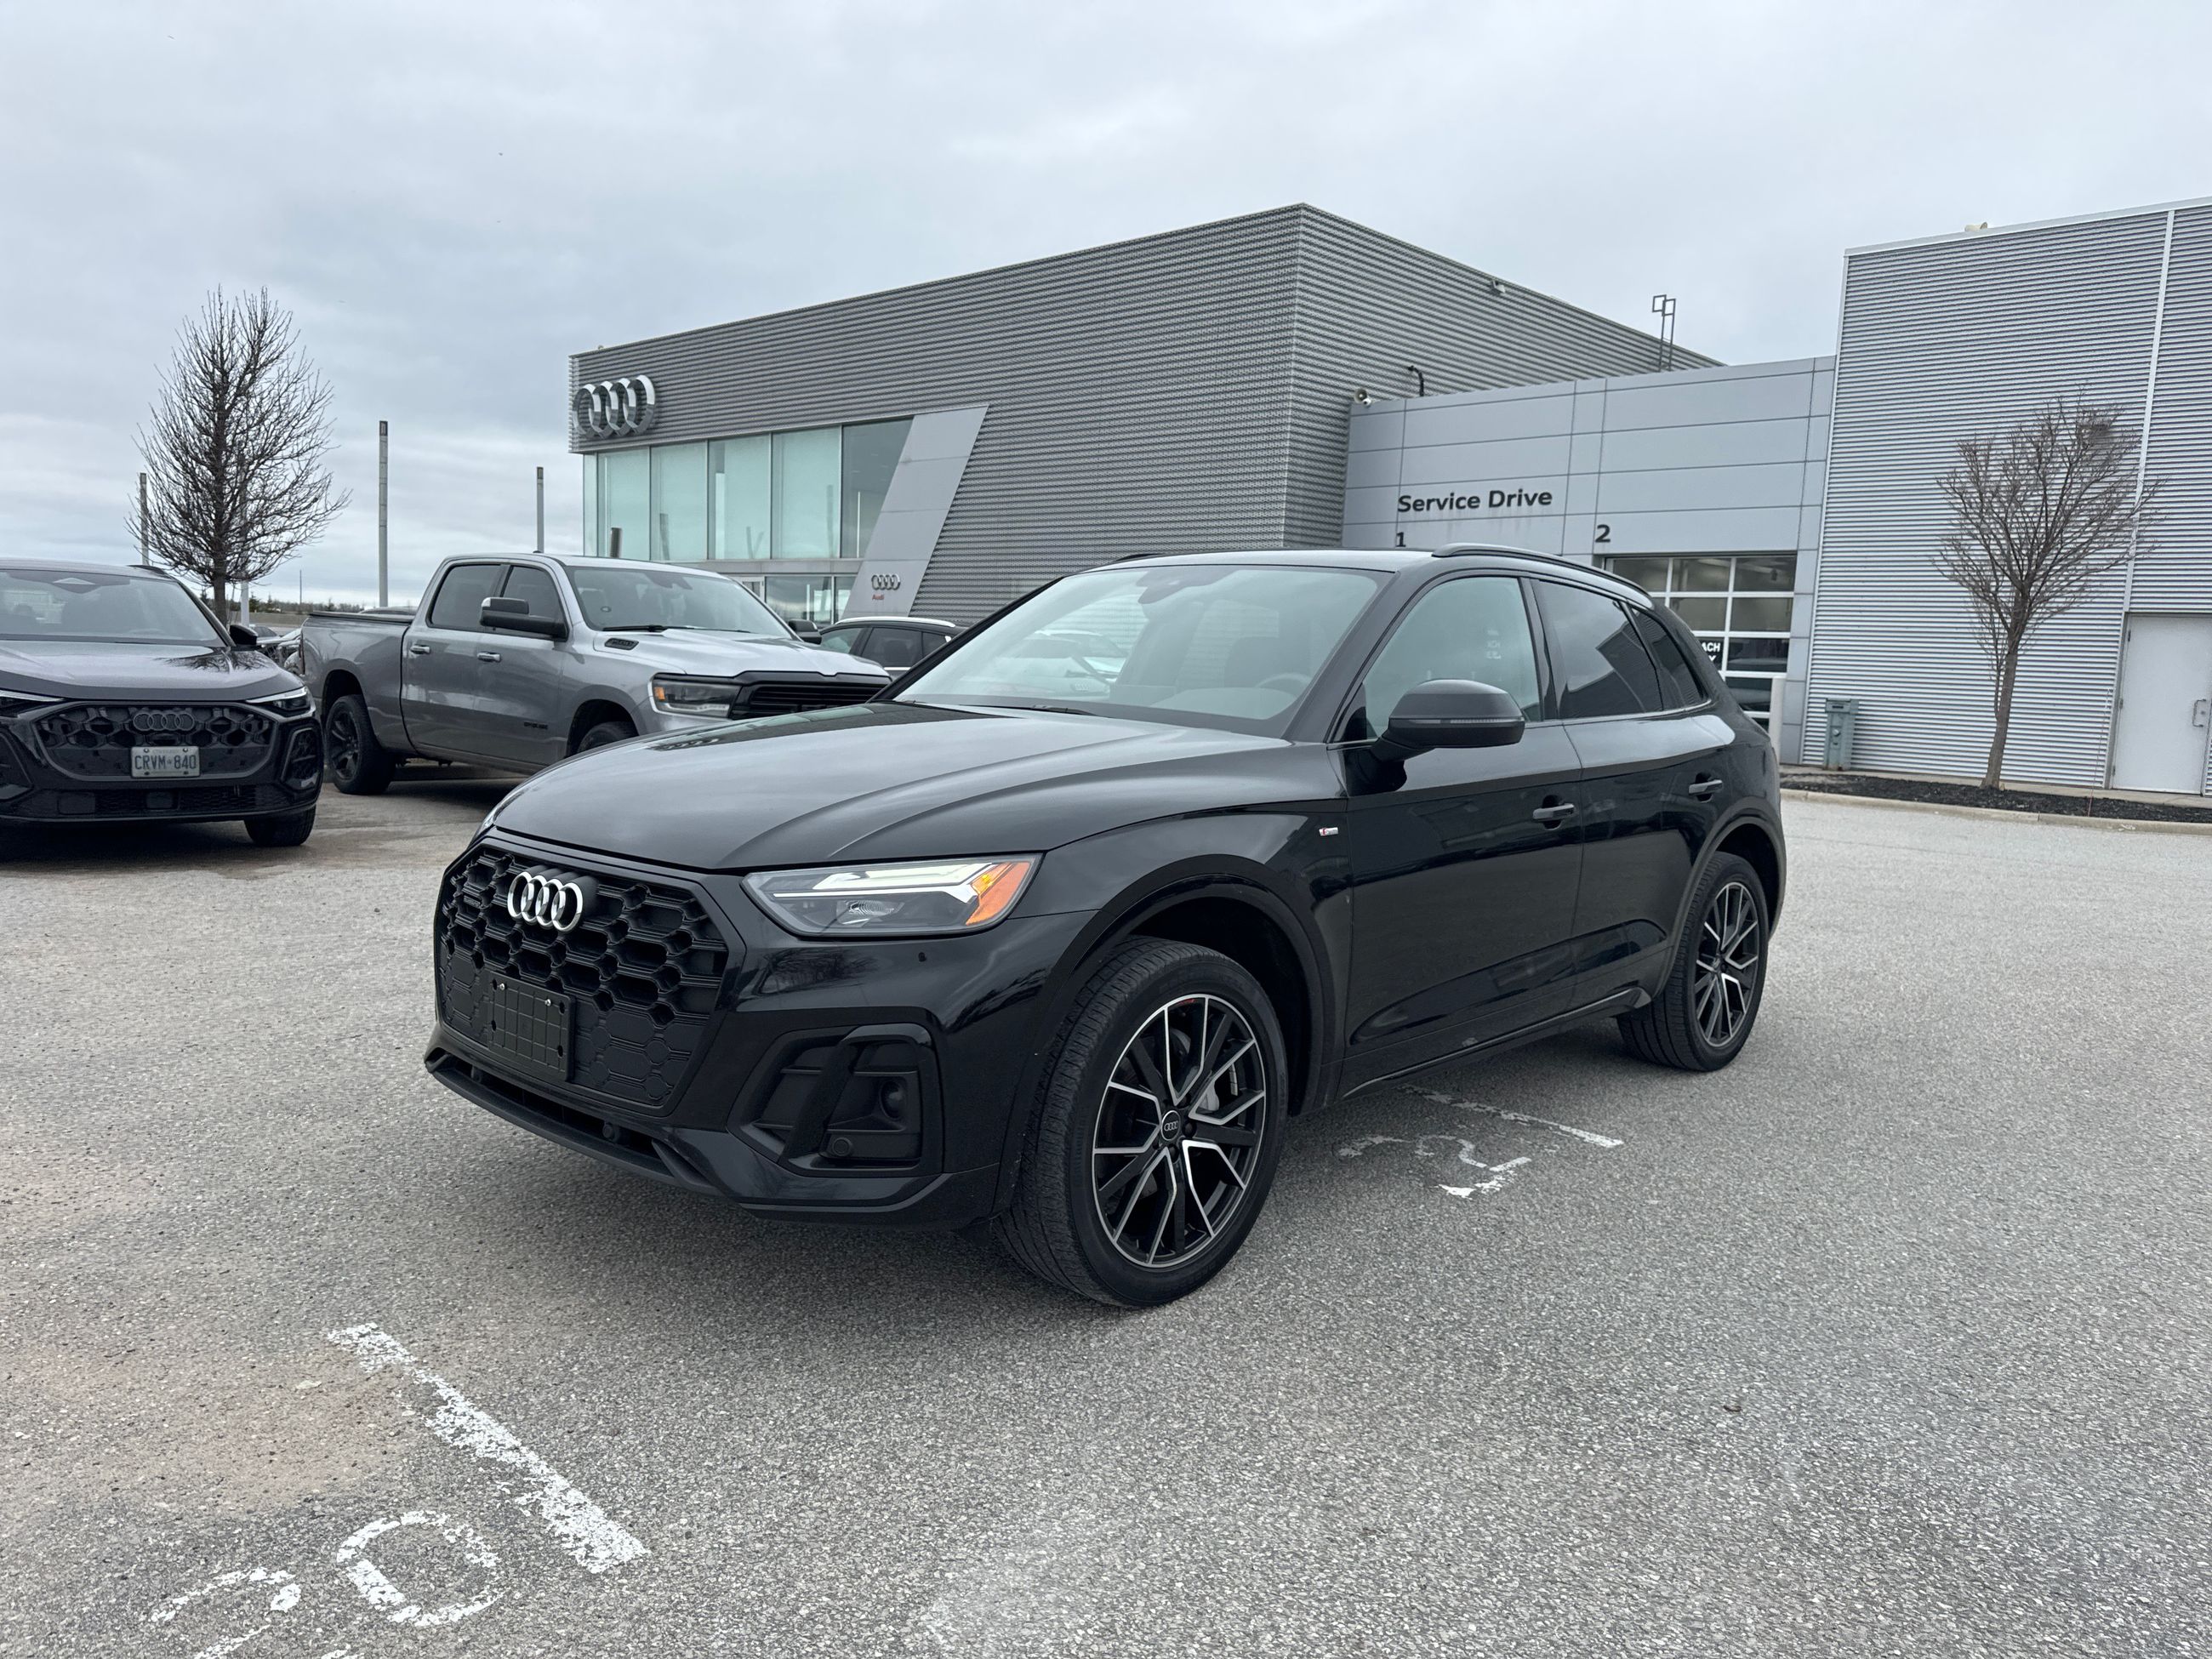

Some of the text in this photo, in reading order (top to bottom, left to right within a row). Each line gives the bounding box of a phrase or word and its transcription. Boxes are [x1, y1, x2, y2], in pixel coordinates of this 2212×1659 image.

[1397, 488, 1553, 513] Service Drive
[1396, 532, 1406, 547] 1
[1595, 524, 1611, 543] 2
